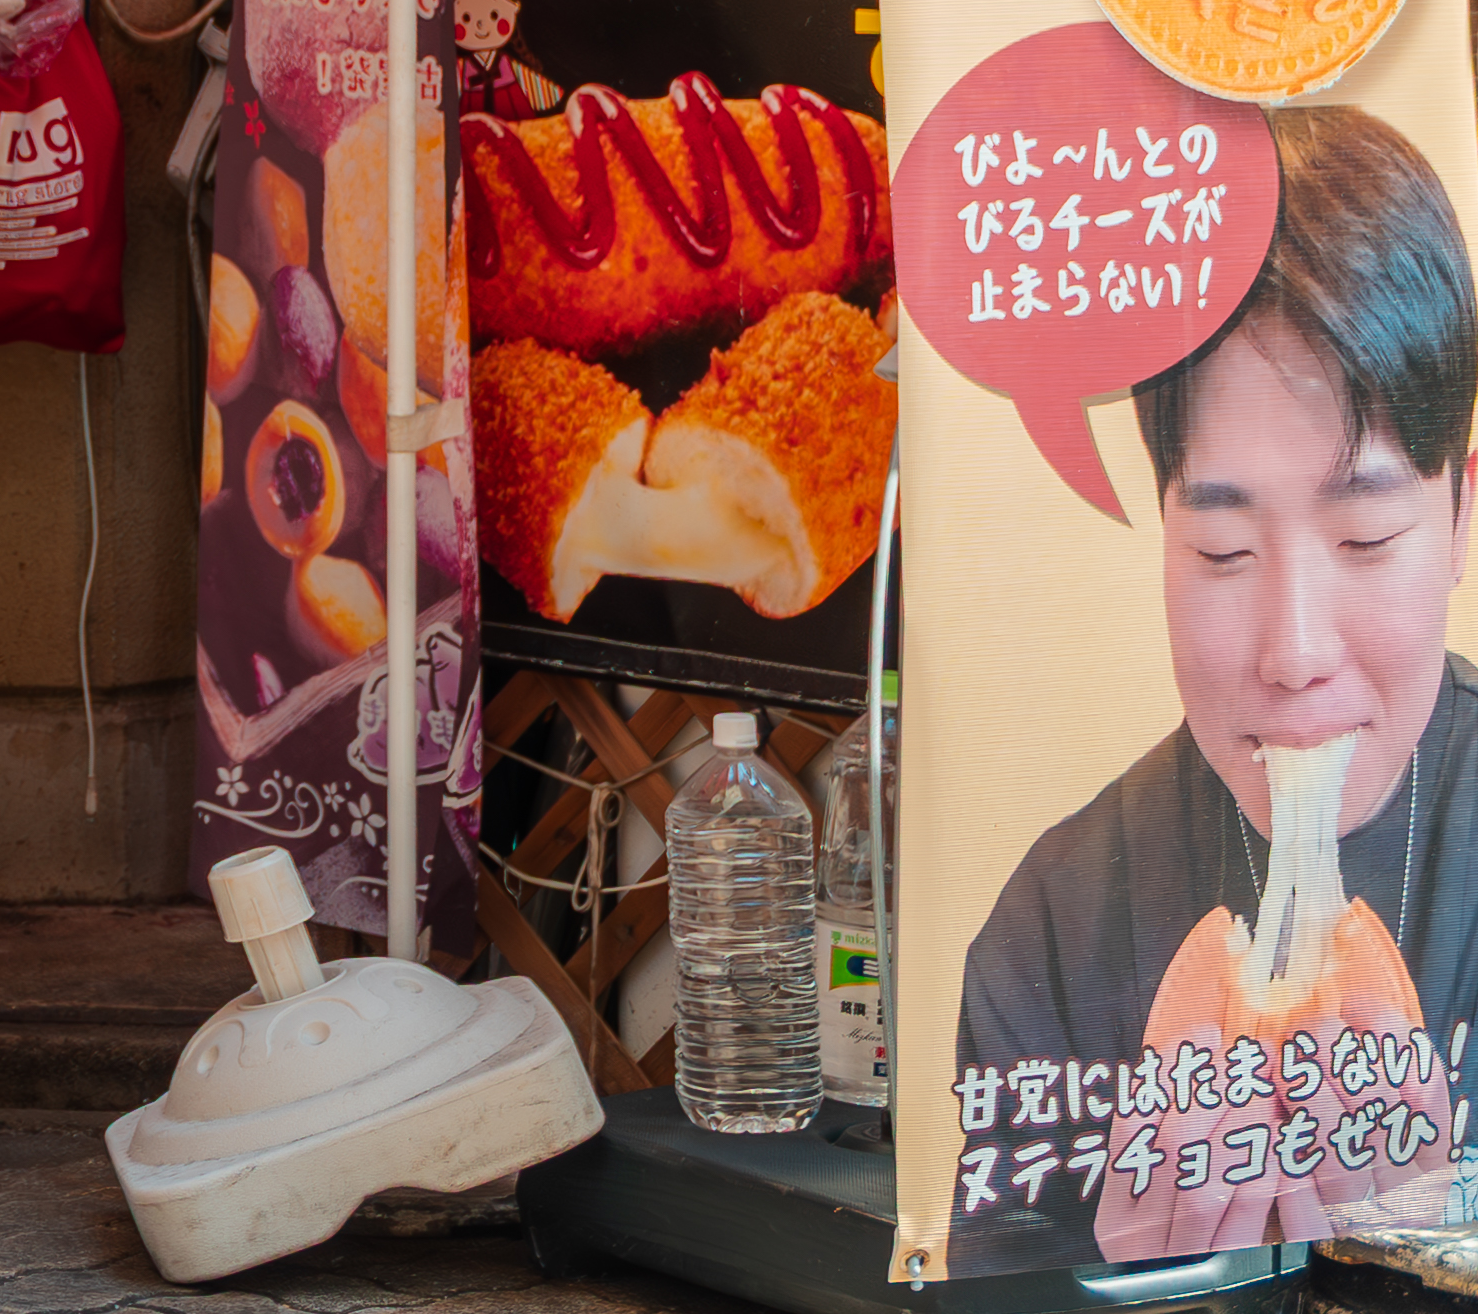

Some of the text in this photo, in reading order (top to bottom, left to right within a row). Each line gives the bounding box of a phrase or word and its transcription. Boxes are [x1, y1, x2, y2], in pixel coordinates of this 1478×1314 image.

[957, 184, 1227, 254] びるチーズが
[968, 256, 1213, 323] 止まらない！
[844, 932, 876, 945] mizka
[954, 1020, 1469, 1133] 甘党にはたまらない！
[960, 1097, 1469, 1214] ヌテラチョコもぜひ！
